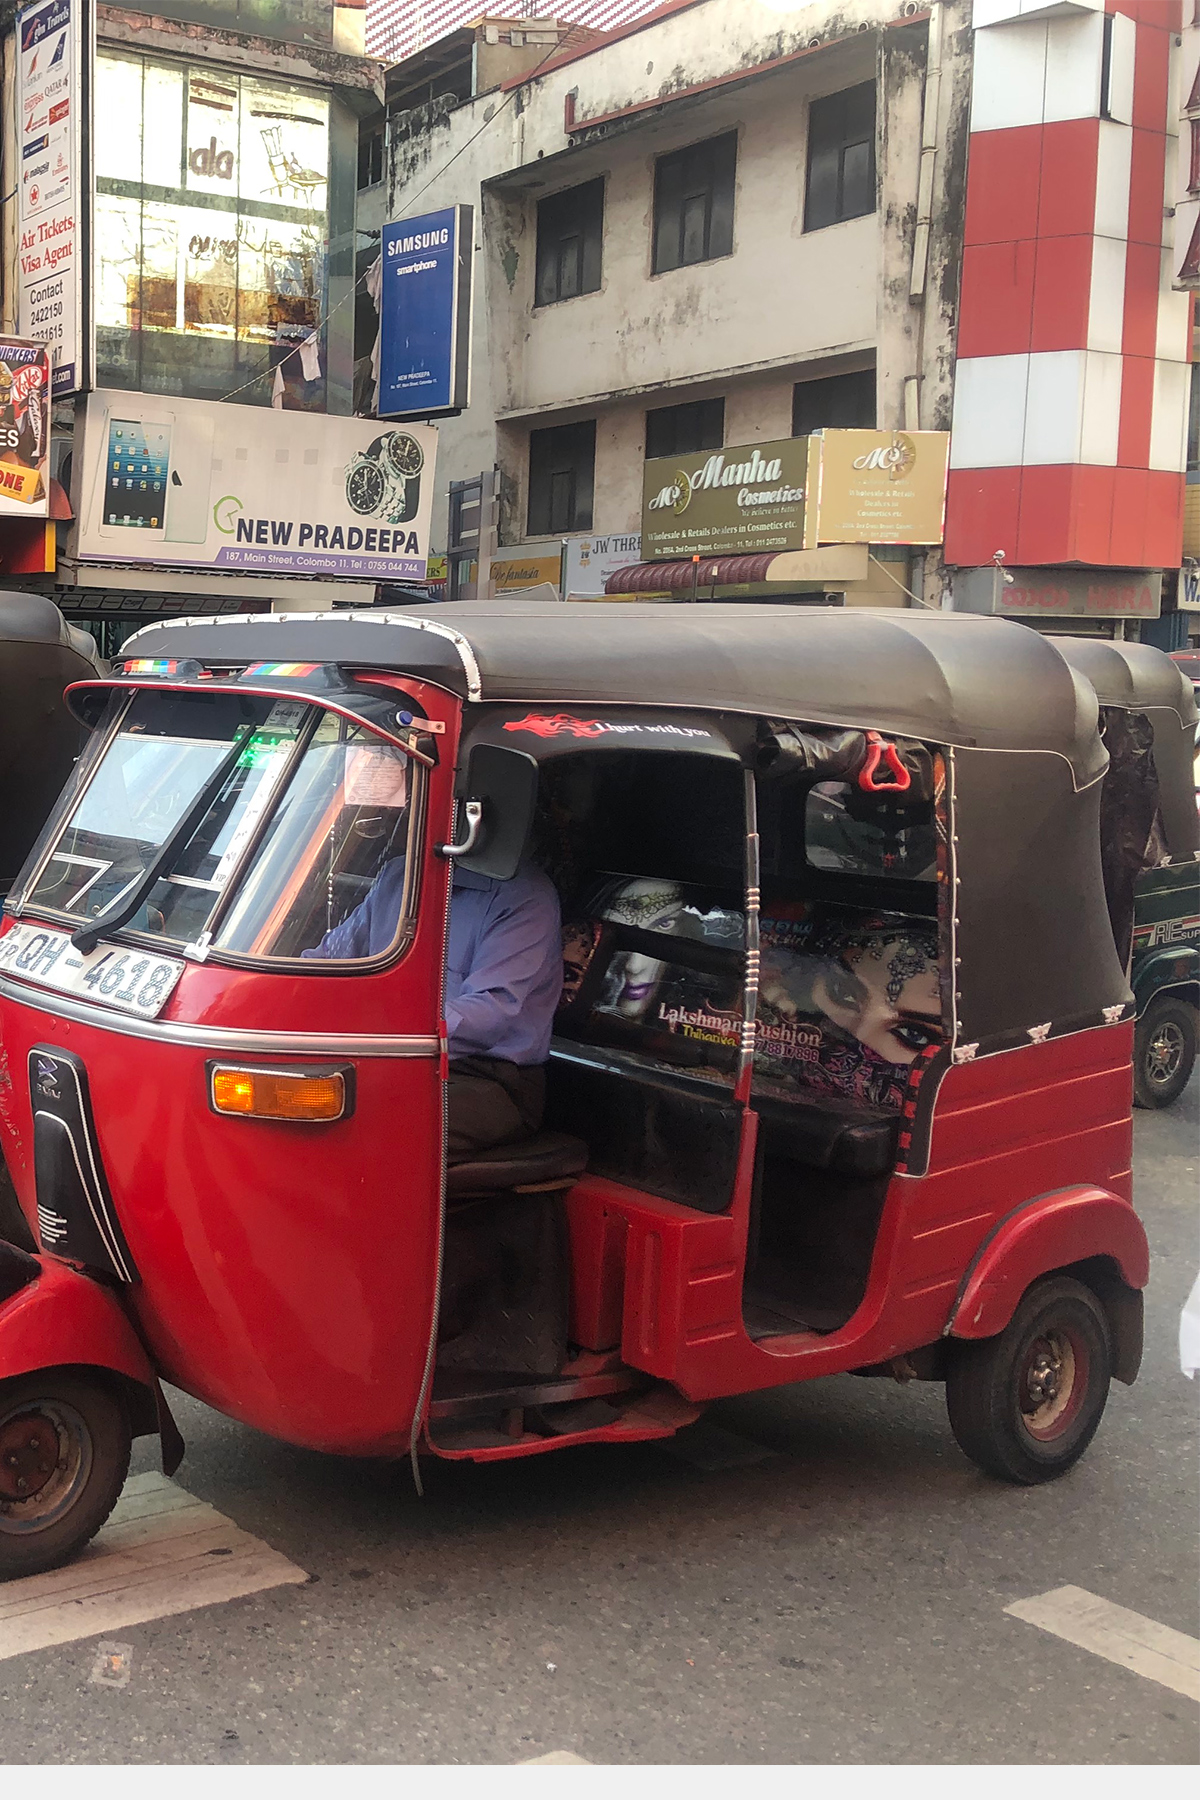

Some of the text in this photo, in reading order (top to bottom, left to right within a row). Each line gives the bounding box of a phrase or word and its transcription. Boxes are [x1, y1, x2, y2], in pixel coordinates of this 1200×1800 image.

[20, 231, 36, 252] Air
[388, 228, 449, 257] SAMSUNG
[20, 240, 73, 276] Visa Agent
[397, 259, 438, 276] smartphone
[30, 279, 63, 305] Contact
[30, 301, 63, 326] 2422150
[691, 450, 783, 490] Manha
[737, 484, 804, 507] Cosmetics
[236, 519, 419, 555] NEW PRADEEPA
[648, 529, 680, 541] Wholesale
[681, 530, 687, 538] &
[687, 526, 710, 538] Retails
[712, 524, 738, 536] Dealers
[739, 524, 746, 533] in
[747, 520, 783, 533] Cosmetics
[225, 551, 242, 563] 187,
[244, 553, 266, 564] Main
[268, 555, 294, 567] Street,
[296, 556, 338, 568] Colombo
[368, 560, 385, 570] 0755
[386, 562, 402, 571] 044
[1087, 586, 1154, 610] HARA
[608, 722, 643, 732] hurt
[647, 725, 681, 735] with
[681, 727, 711, 738] you
[15, 933, 69, 976] QH
[83, 951, 173, 1008] 4618
[659, 1002, 742, 1034] Lakshman
[768, 1042, 819, 1062] 8817896
